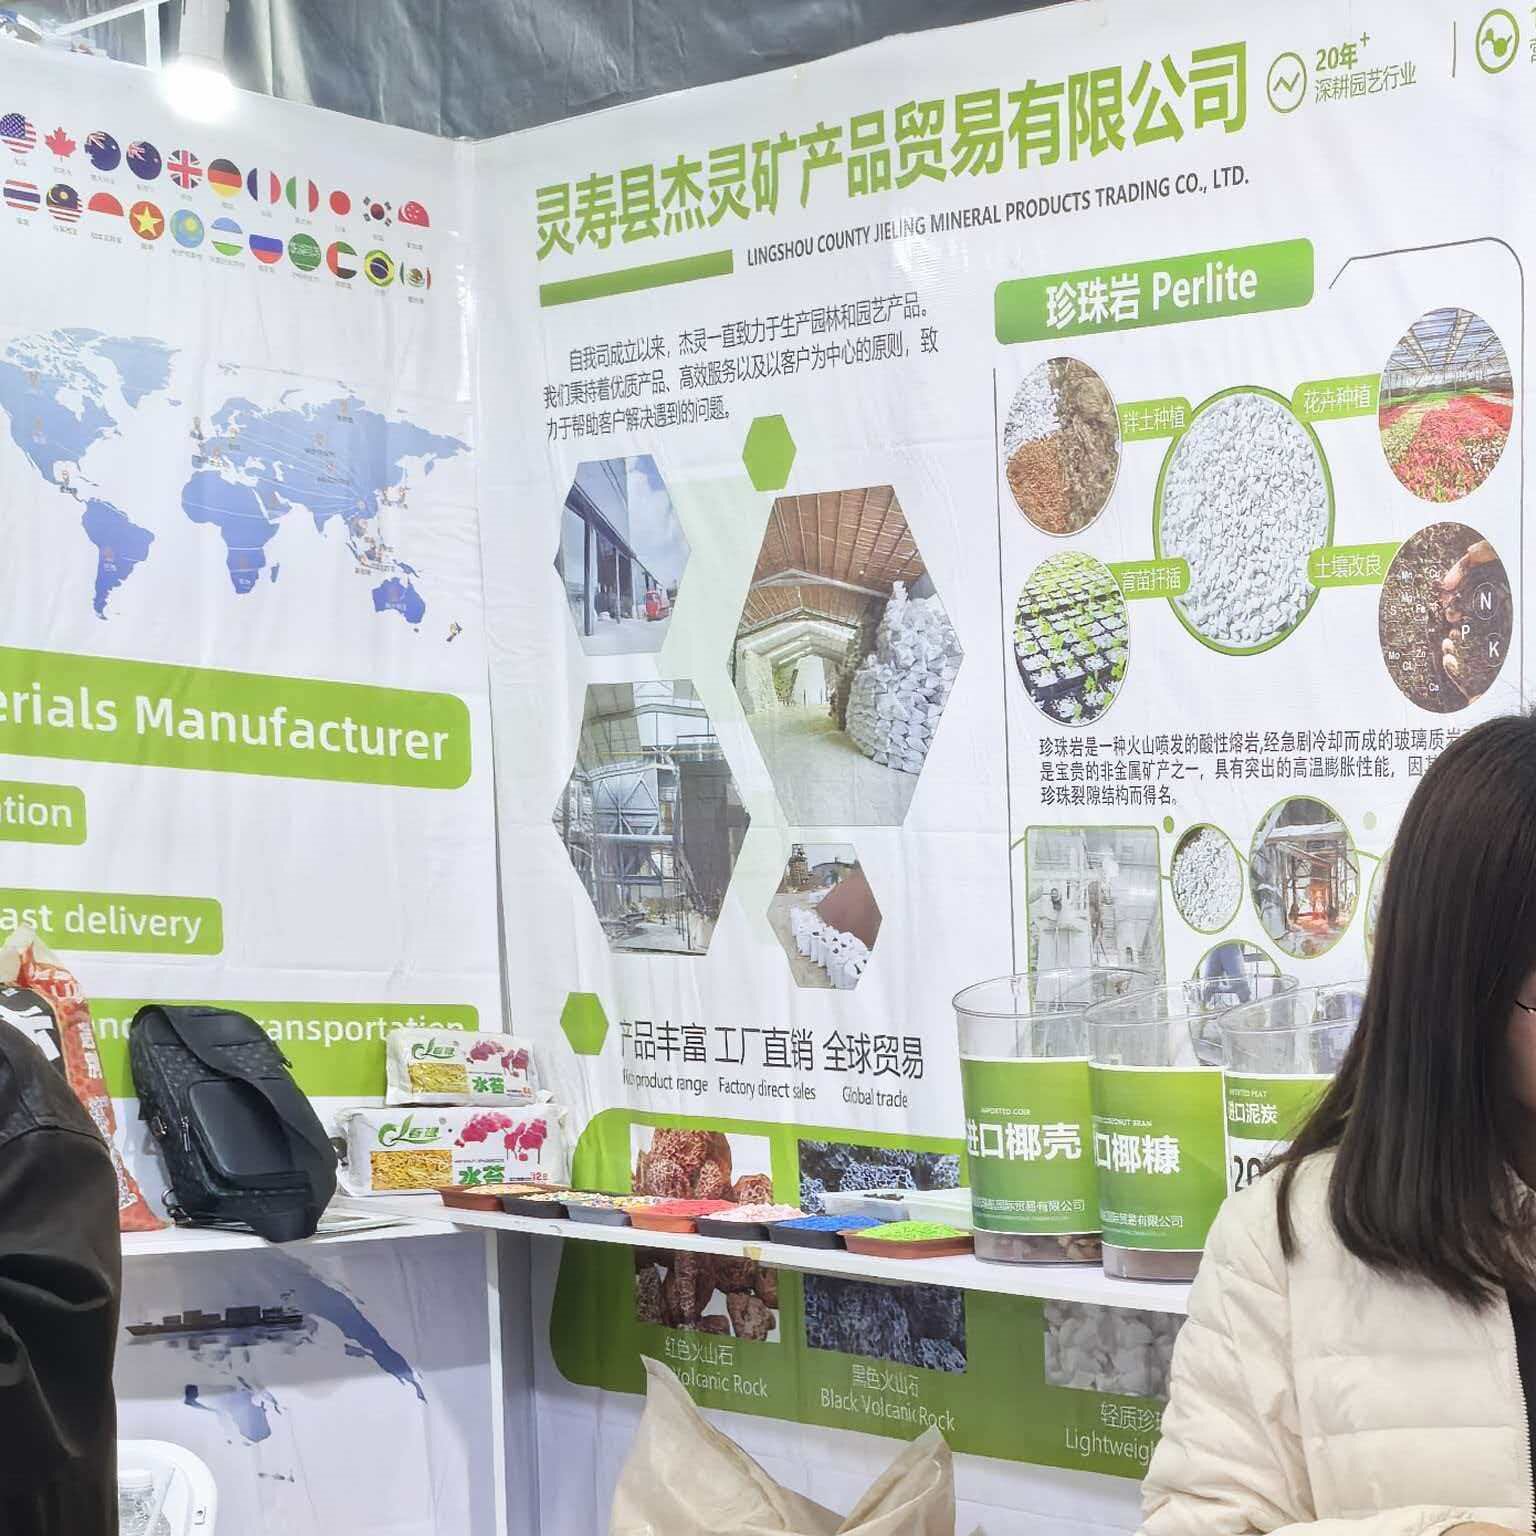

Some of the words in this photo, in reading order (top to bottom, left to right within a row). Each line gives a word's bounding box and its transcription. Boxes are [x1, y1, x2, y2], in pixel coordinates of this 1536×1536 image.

[1314, 61, 1417, 103] 深耕园艺行业
[536, 41, 1247, 260] 灵寿县杰灵矿产品贸易有限公司
[747, 236, 814, 266] LINGSHOU
[817, 225, 871, 254] COUNTY
[873, 215, 926, 242] JIELING
[930, 206, 1001, 233] MINERAL
[1005, 190, 1091, 222] PRODUCTS
[1095, 179, 1171, 208] TRADING
[1213, 165, 1249, 189] LTD.
[1045, 274, 1140, 331] 珍珠岩
[1151, 264, 1258, 311] Perlite
[1303, 385, 1371, 414] 花卉种植
[1316, 554, 1382, 579] 土壤改良
[135, 695, 449, 761] Manufacturer
[0, 794, 73, 828] tion
[65, 904, 202, 945] delivery
[715, 1026, 814, 1071] 工厂直销
[823, 1029, 924, 1080] 全球贸易
[636, 1071, 673, 1090] product
[676, 1077, 709, 1096] range
[719, 1076, 756, 1098] Factory
[758, 1079, 791, 1097] direct
[793, 1080, 816, 1100] sales
[842, 1085, 875, 1104] Global
[876, 1088, 908, 1108] trade
[967, 1119, 1082, 1160] 进口椰壳
[665, 1336, 735, 1367] 红色火山石
[734, 1374, 769, 1399] Rock
[852, 1364, 920, 1397] 黑色火山石
[820, 1387, 857, 1412] Black
[860, 1394, 918, 1424] Volcanic
[919, 1406, 956, 1432] Rock
